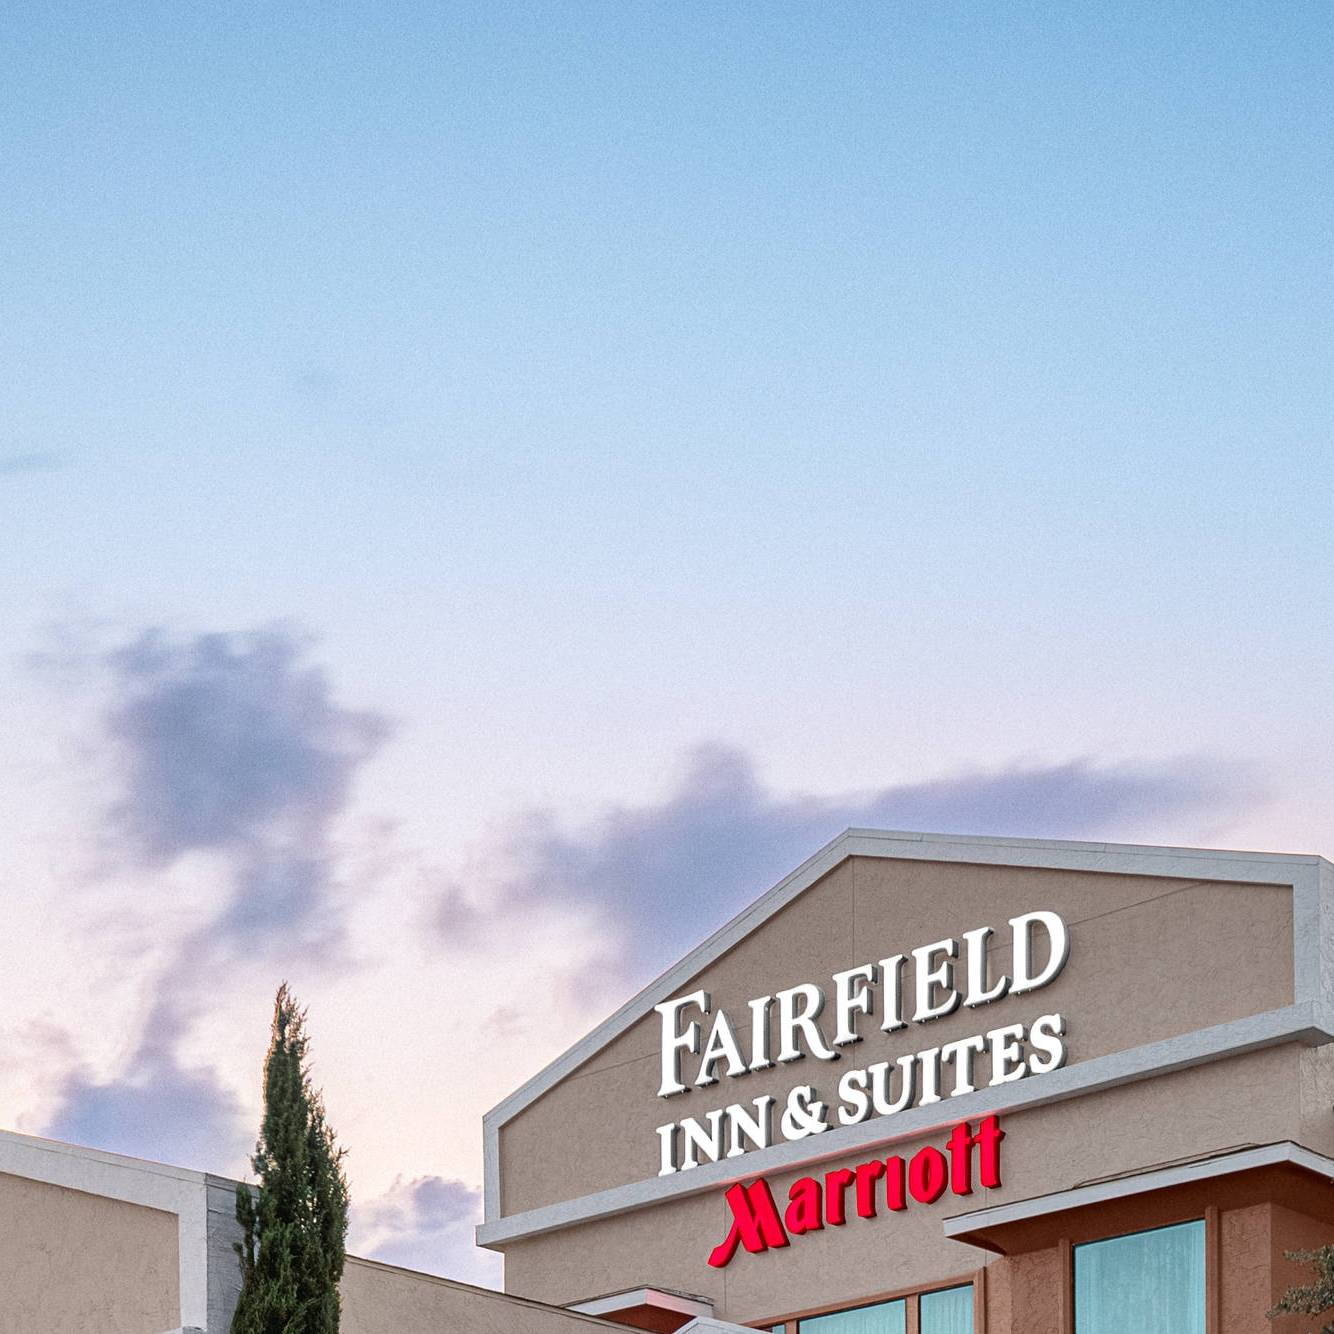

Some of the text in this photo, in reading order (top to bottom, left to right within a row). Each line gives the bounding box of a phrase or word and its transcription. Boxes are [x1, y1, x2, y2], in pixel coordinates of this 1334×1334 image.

[654, 910, 1070, 1099] FAIRFIELD
[655, 1013, 1066, 1177] INN & SUITES
[707, 1114, 1006, 1268] Marriott
